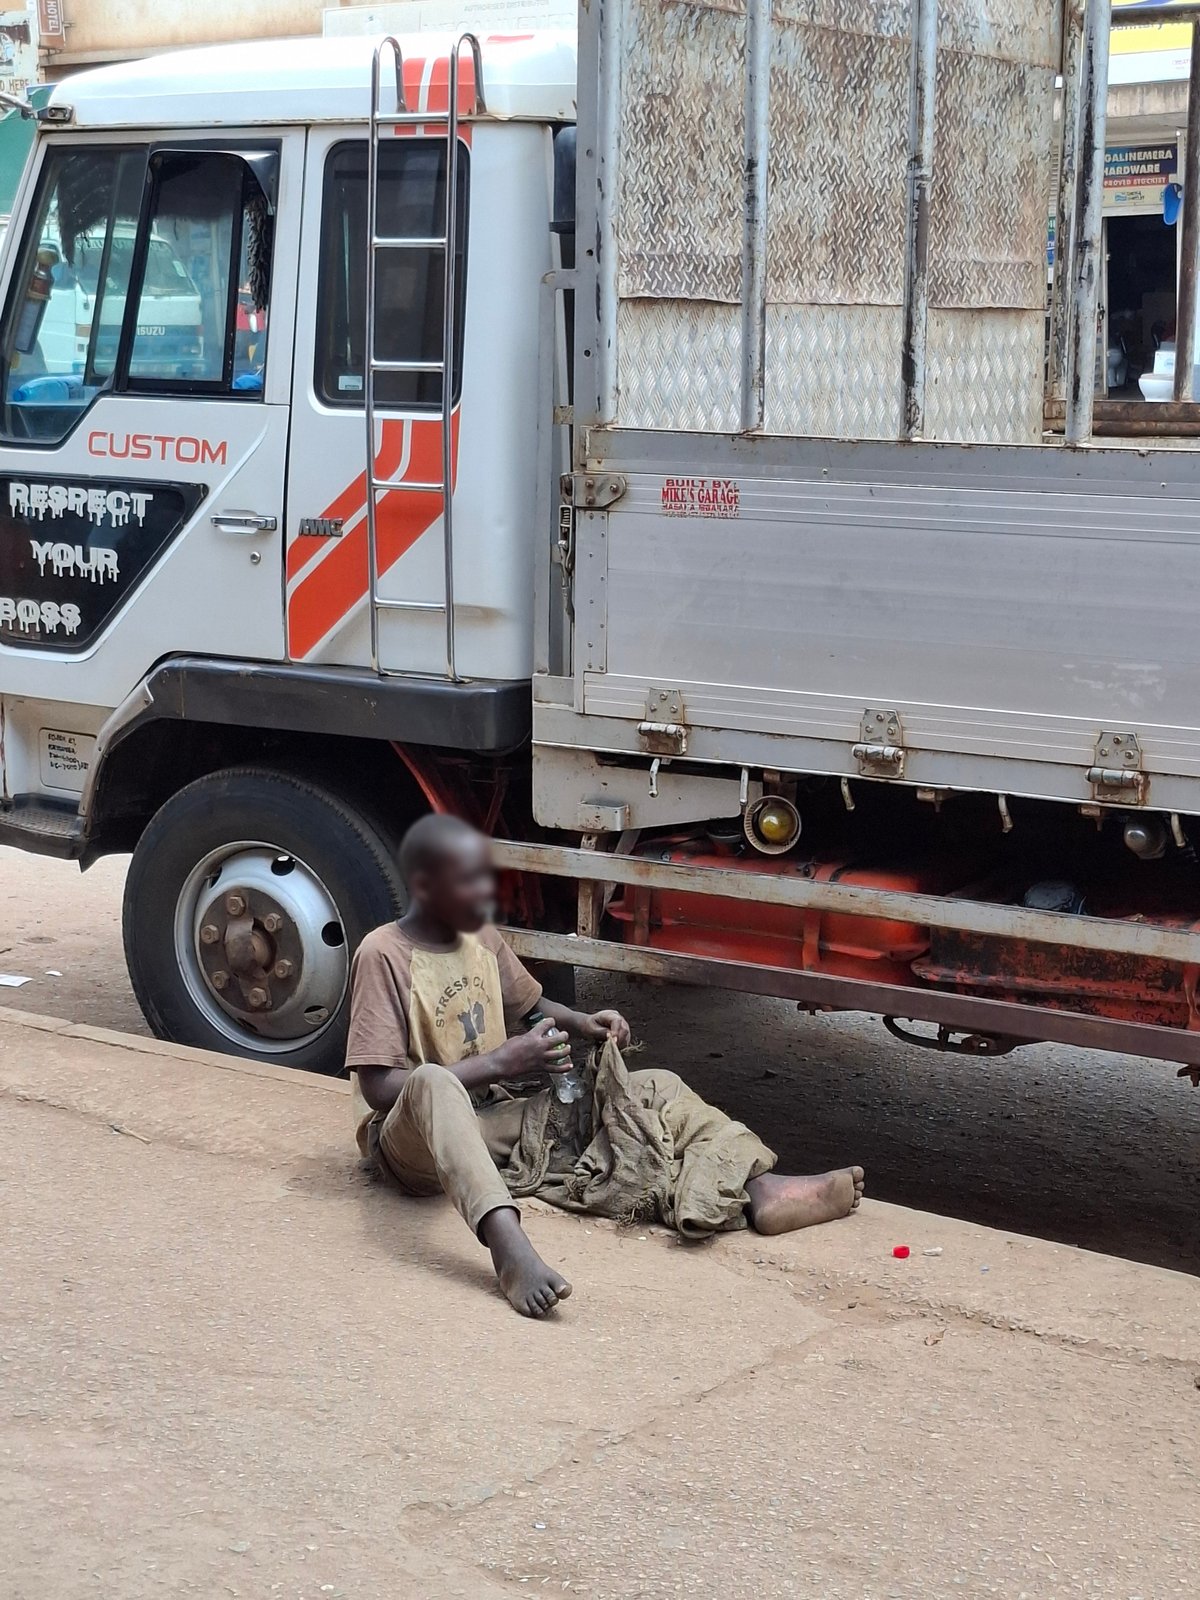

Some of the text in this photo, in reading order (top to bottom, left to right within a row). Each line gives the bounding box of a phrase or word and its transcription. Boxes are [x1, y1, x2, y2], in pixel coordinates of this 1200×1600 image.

[47, 0, 59, 31] HOTEL
[137, 326, 166, 336] ISUZU
[88, 431, 227, 465] CUSTOM
[661, 487, 739, 505] MIKE'S GARAGE
[666, 479, 707, 487] BUILT
[9, 482, 154, 528] RESPECT
[29, 539, 120, 585] YOUR
[0, 597, 82, 636] BOSS
